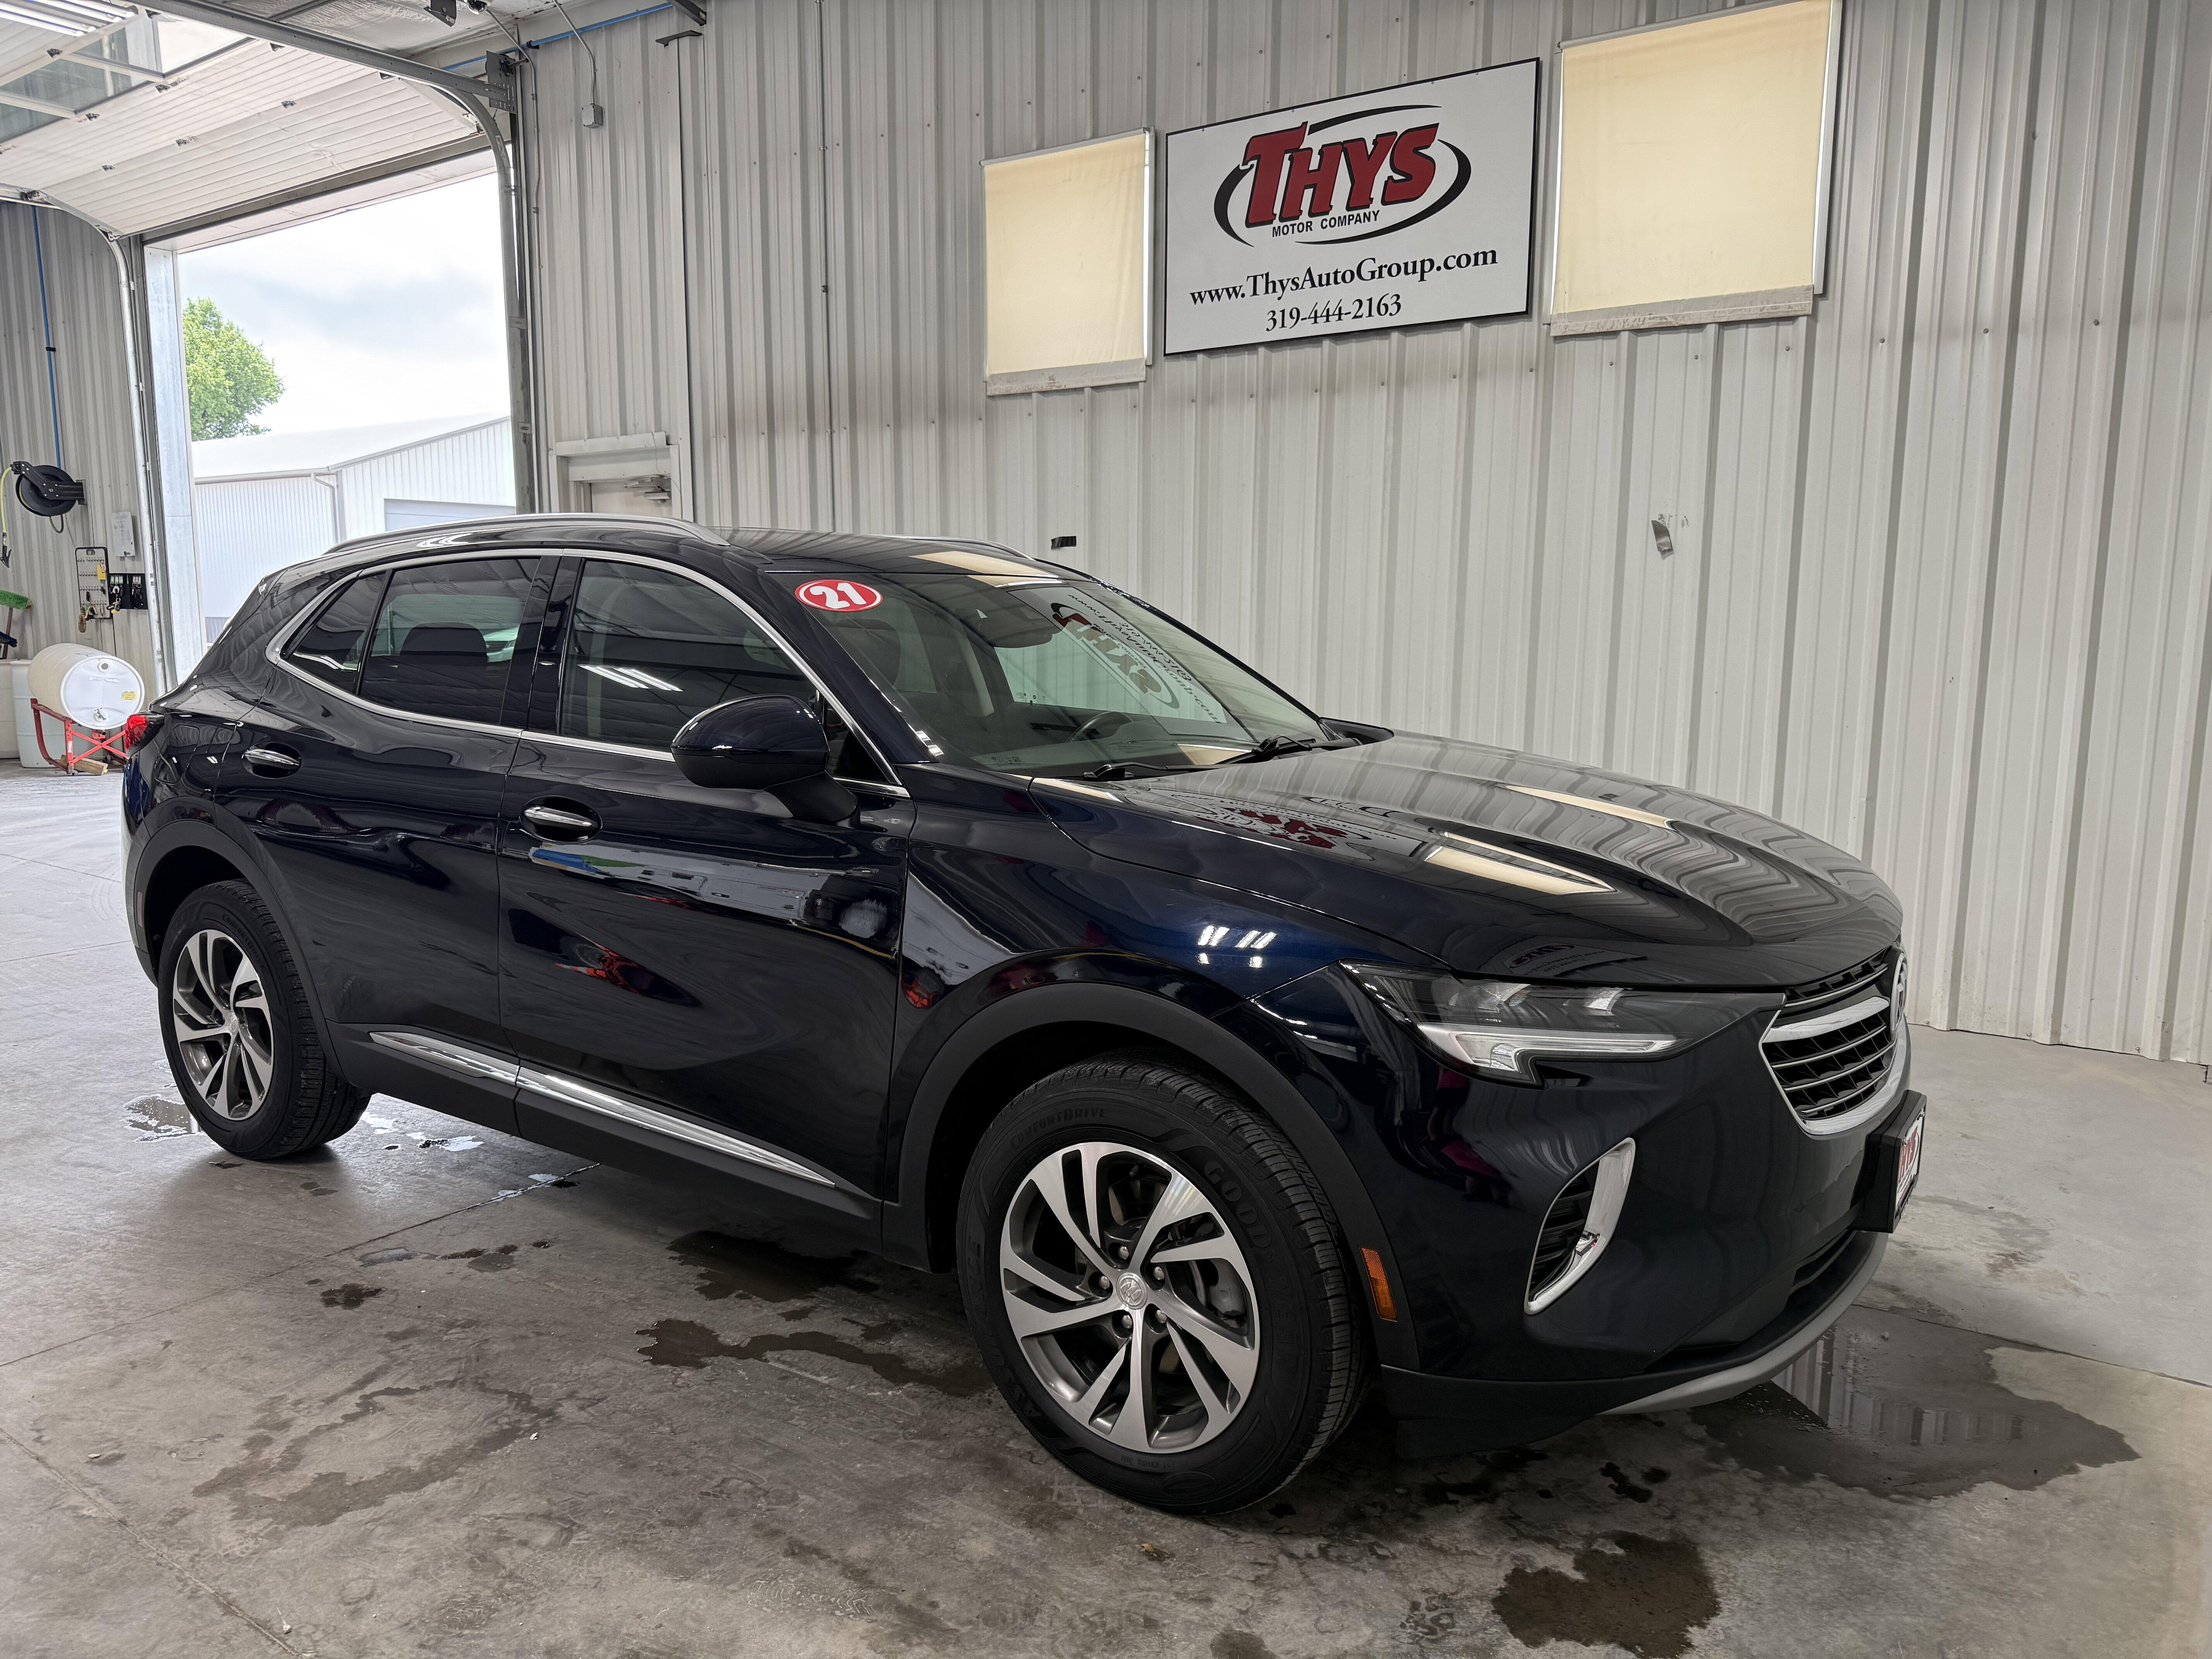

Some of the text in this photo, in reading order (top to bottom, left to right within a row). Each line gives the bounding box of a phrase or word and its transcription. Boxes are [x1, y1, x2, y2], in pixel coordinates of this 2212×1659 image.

[1242, 121, 1439, 228] THYS
[1272, 210, 1380, 237] MOTOR COMPANY
[1190, 250, 1498, 306] www.ThysAutoGroup.com
[1266, 294, 1402, 332] 319-444-2163
[809, 582, 867, 609] 21
